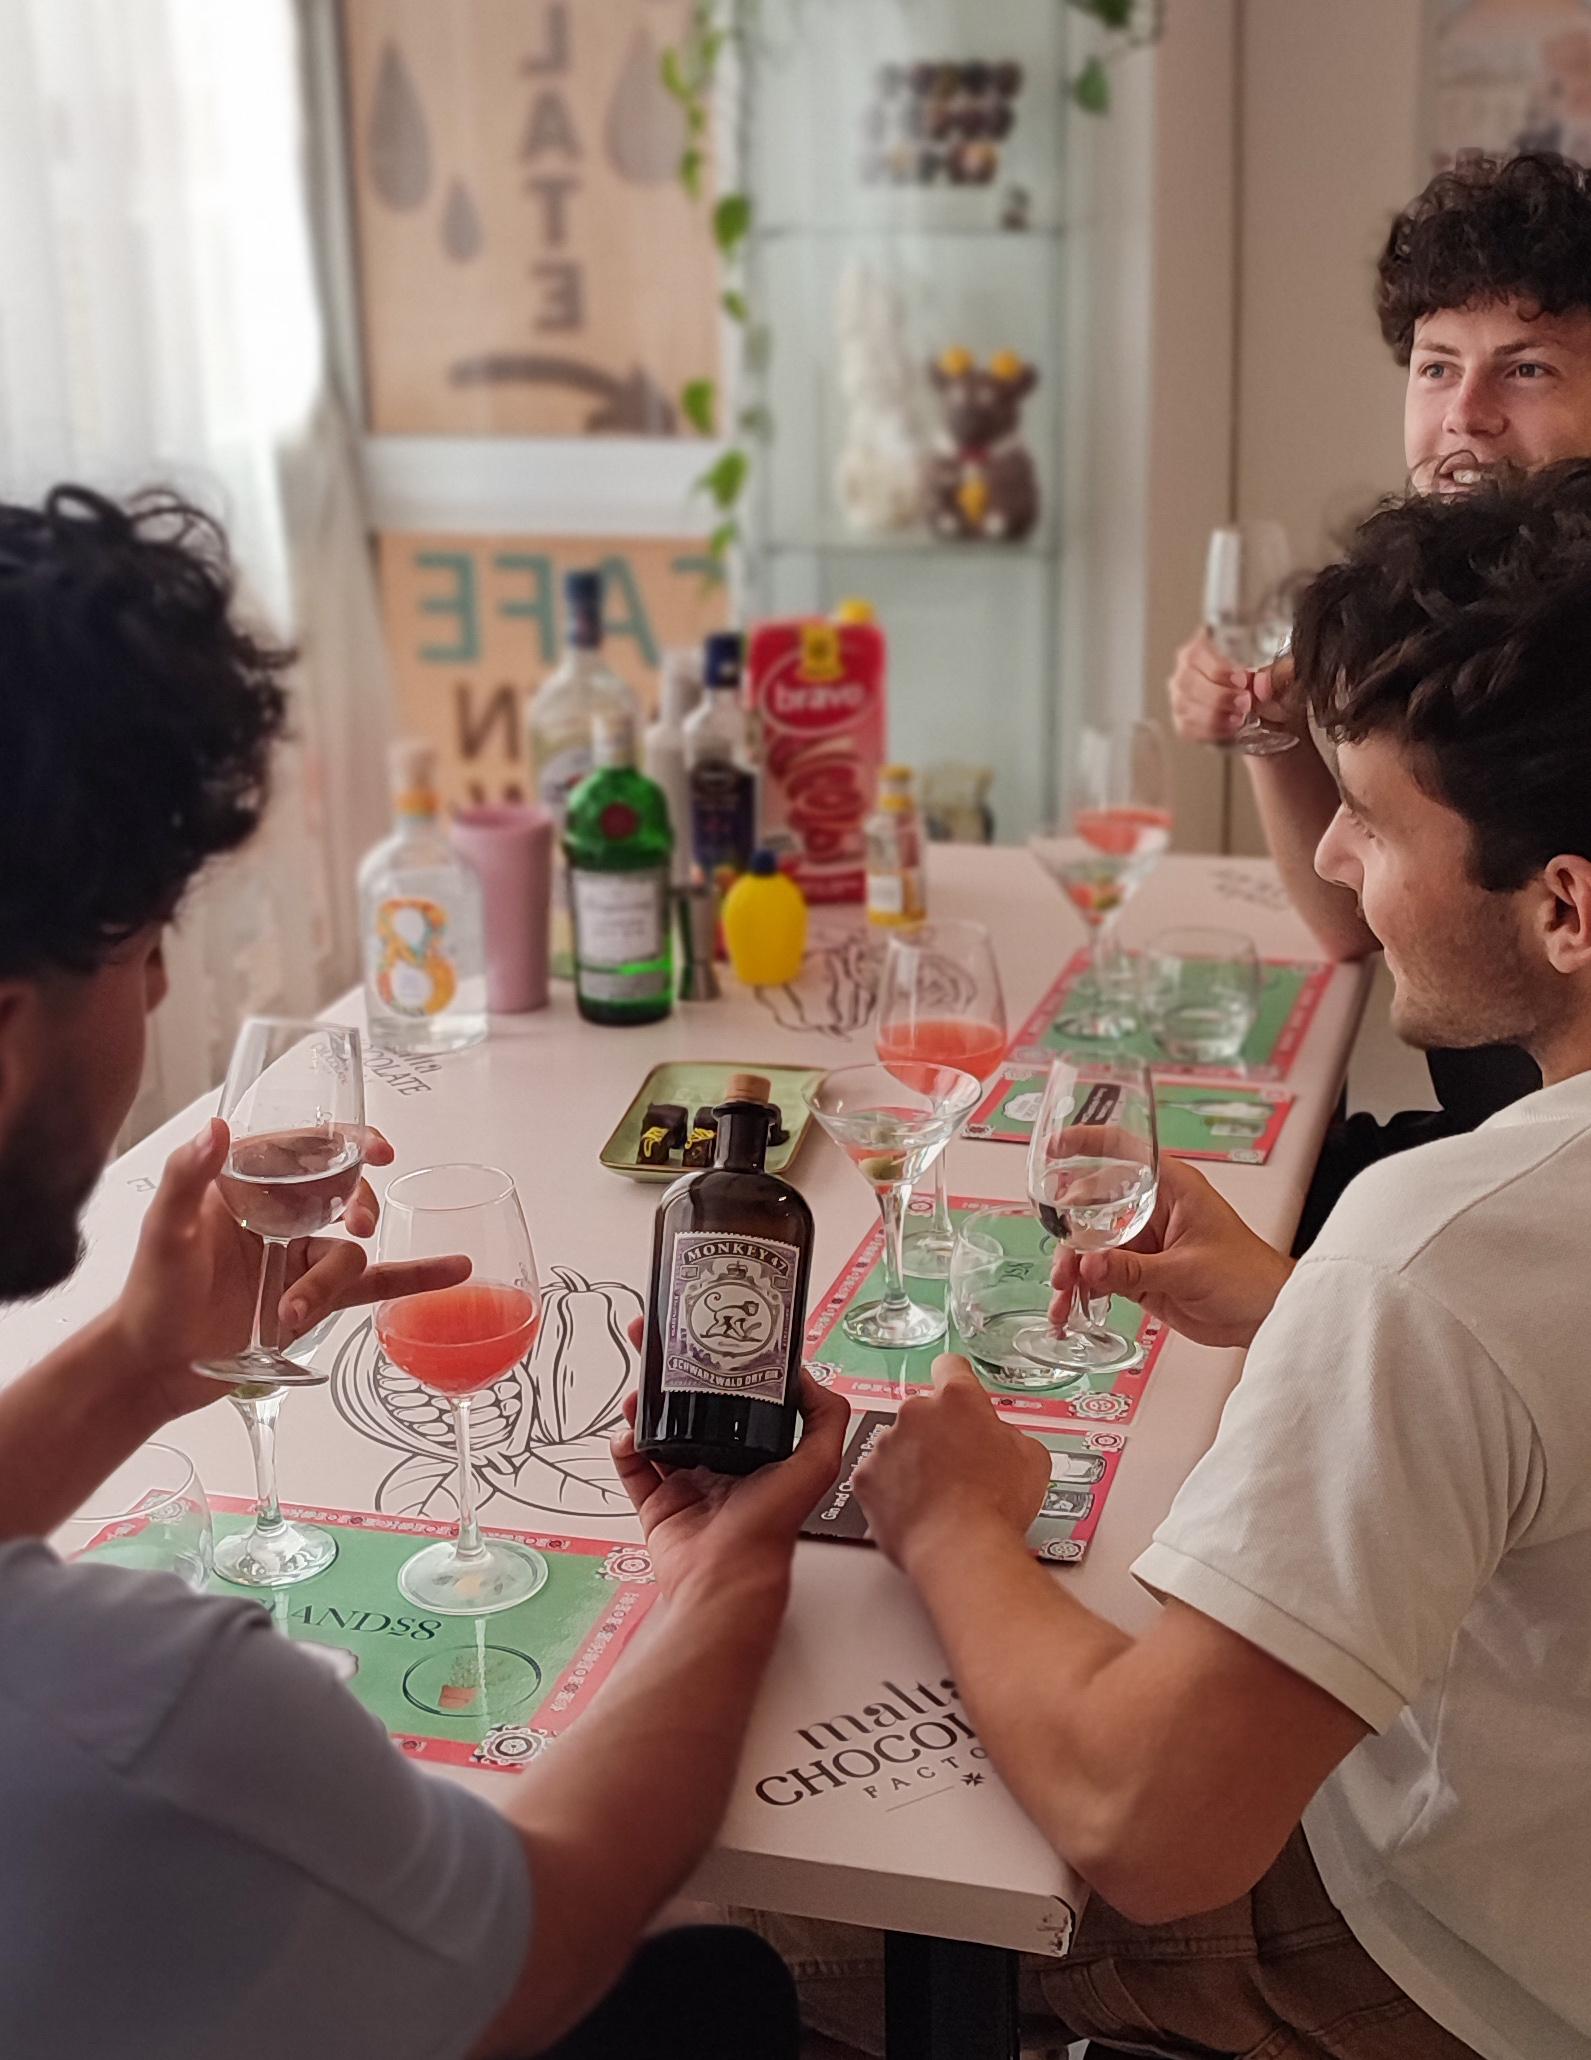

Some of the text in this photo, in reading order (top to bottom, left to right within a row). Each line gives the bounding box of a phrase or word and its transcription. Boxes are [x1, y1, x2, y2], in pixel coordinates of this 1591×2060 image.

[687, 1242, 787, 1270] MONKEY 47
[821, 1507, 841, 1520] Gin
[833, 1491, 851, 1508] and
[863, 1746, 988, 1799] FACTO
